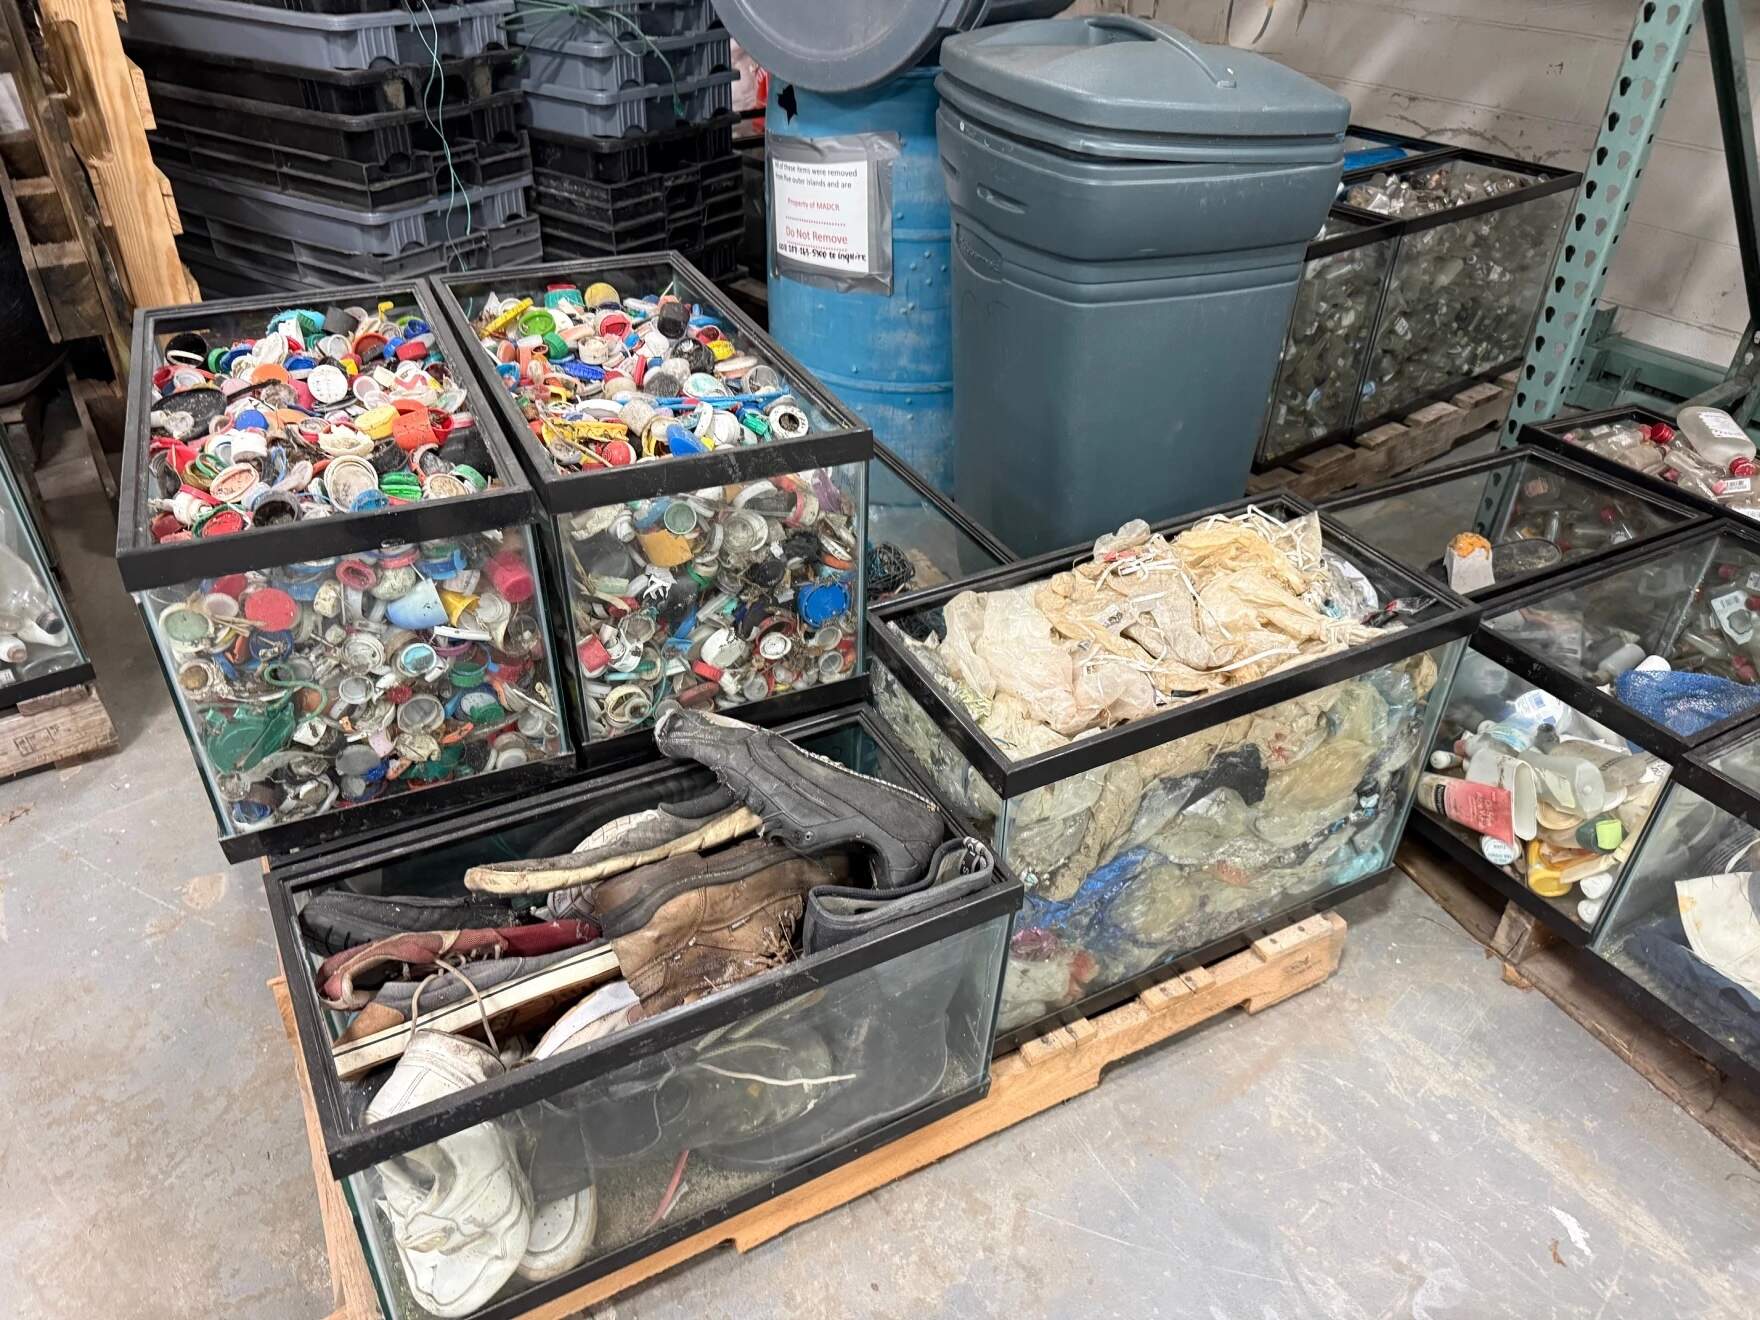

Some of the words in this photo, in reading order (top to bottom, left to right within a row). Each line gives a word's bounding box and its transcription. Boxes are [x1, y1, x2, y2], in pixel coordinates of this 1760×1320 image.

[797, 166, 811, 174] items
[811, 168, 826, 176] were
[828, 168, 858, 177] removed
[827, 179, 840, 189] and
[787, 197, 809, 209] Property
[785, 225, 795, 237] Do
[796, 227, 811, 240] Not
[812, 231, 848, 245] Remove
[829, 250, 836, 259] to
